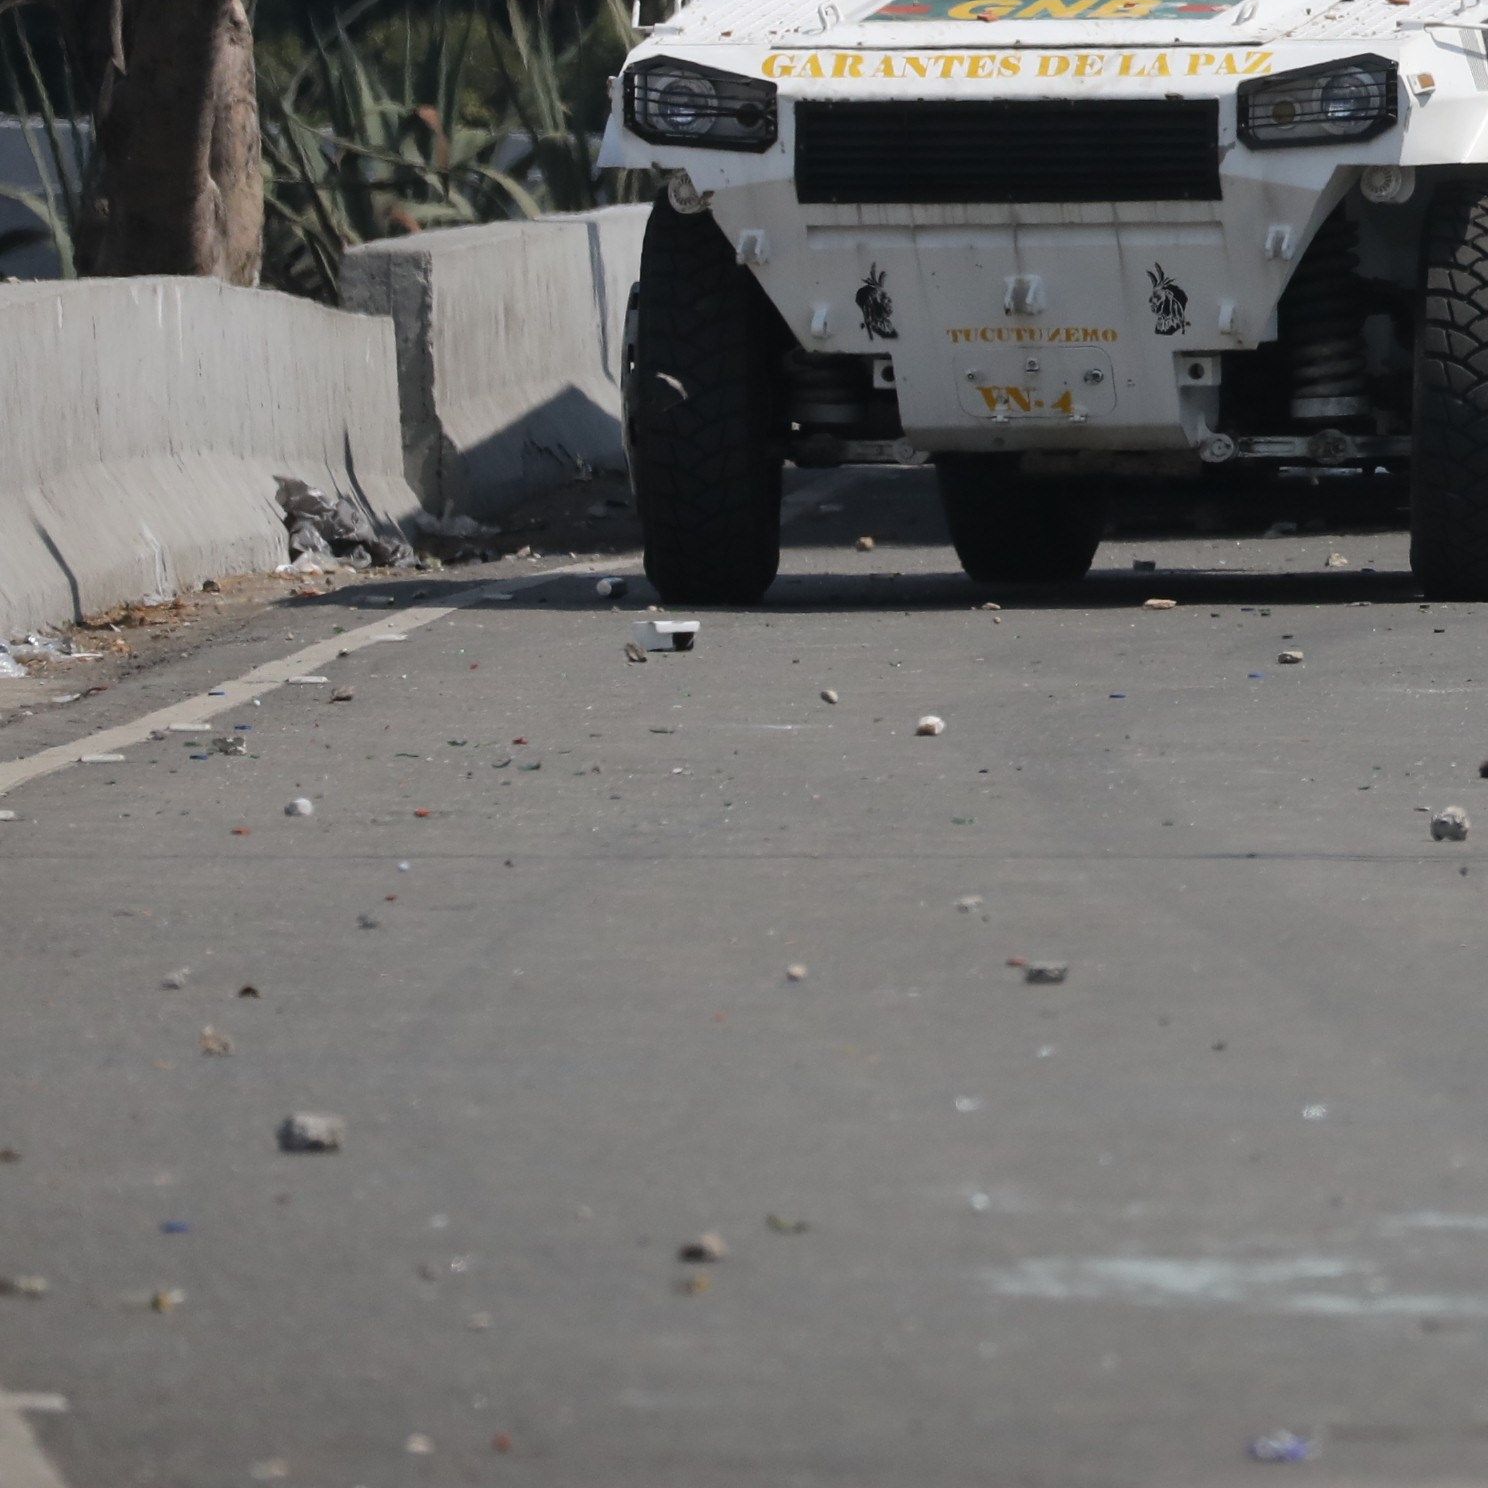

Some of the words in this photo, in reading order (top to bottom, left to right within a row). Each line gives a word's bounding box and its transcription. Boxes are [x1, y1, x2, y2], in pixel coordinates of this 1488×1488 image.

[761, 52, 1022, 79] GARANTES
[1036, 53, 1104, 78] DE
[1117, 52, 1172, 78] LA
[1184, 51, 1275, 77] PAZ
